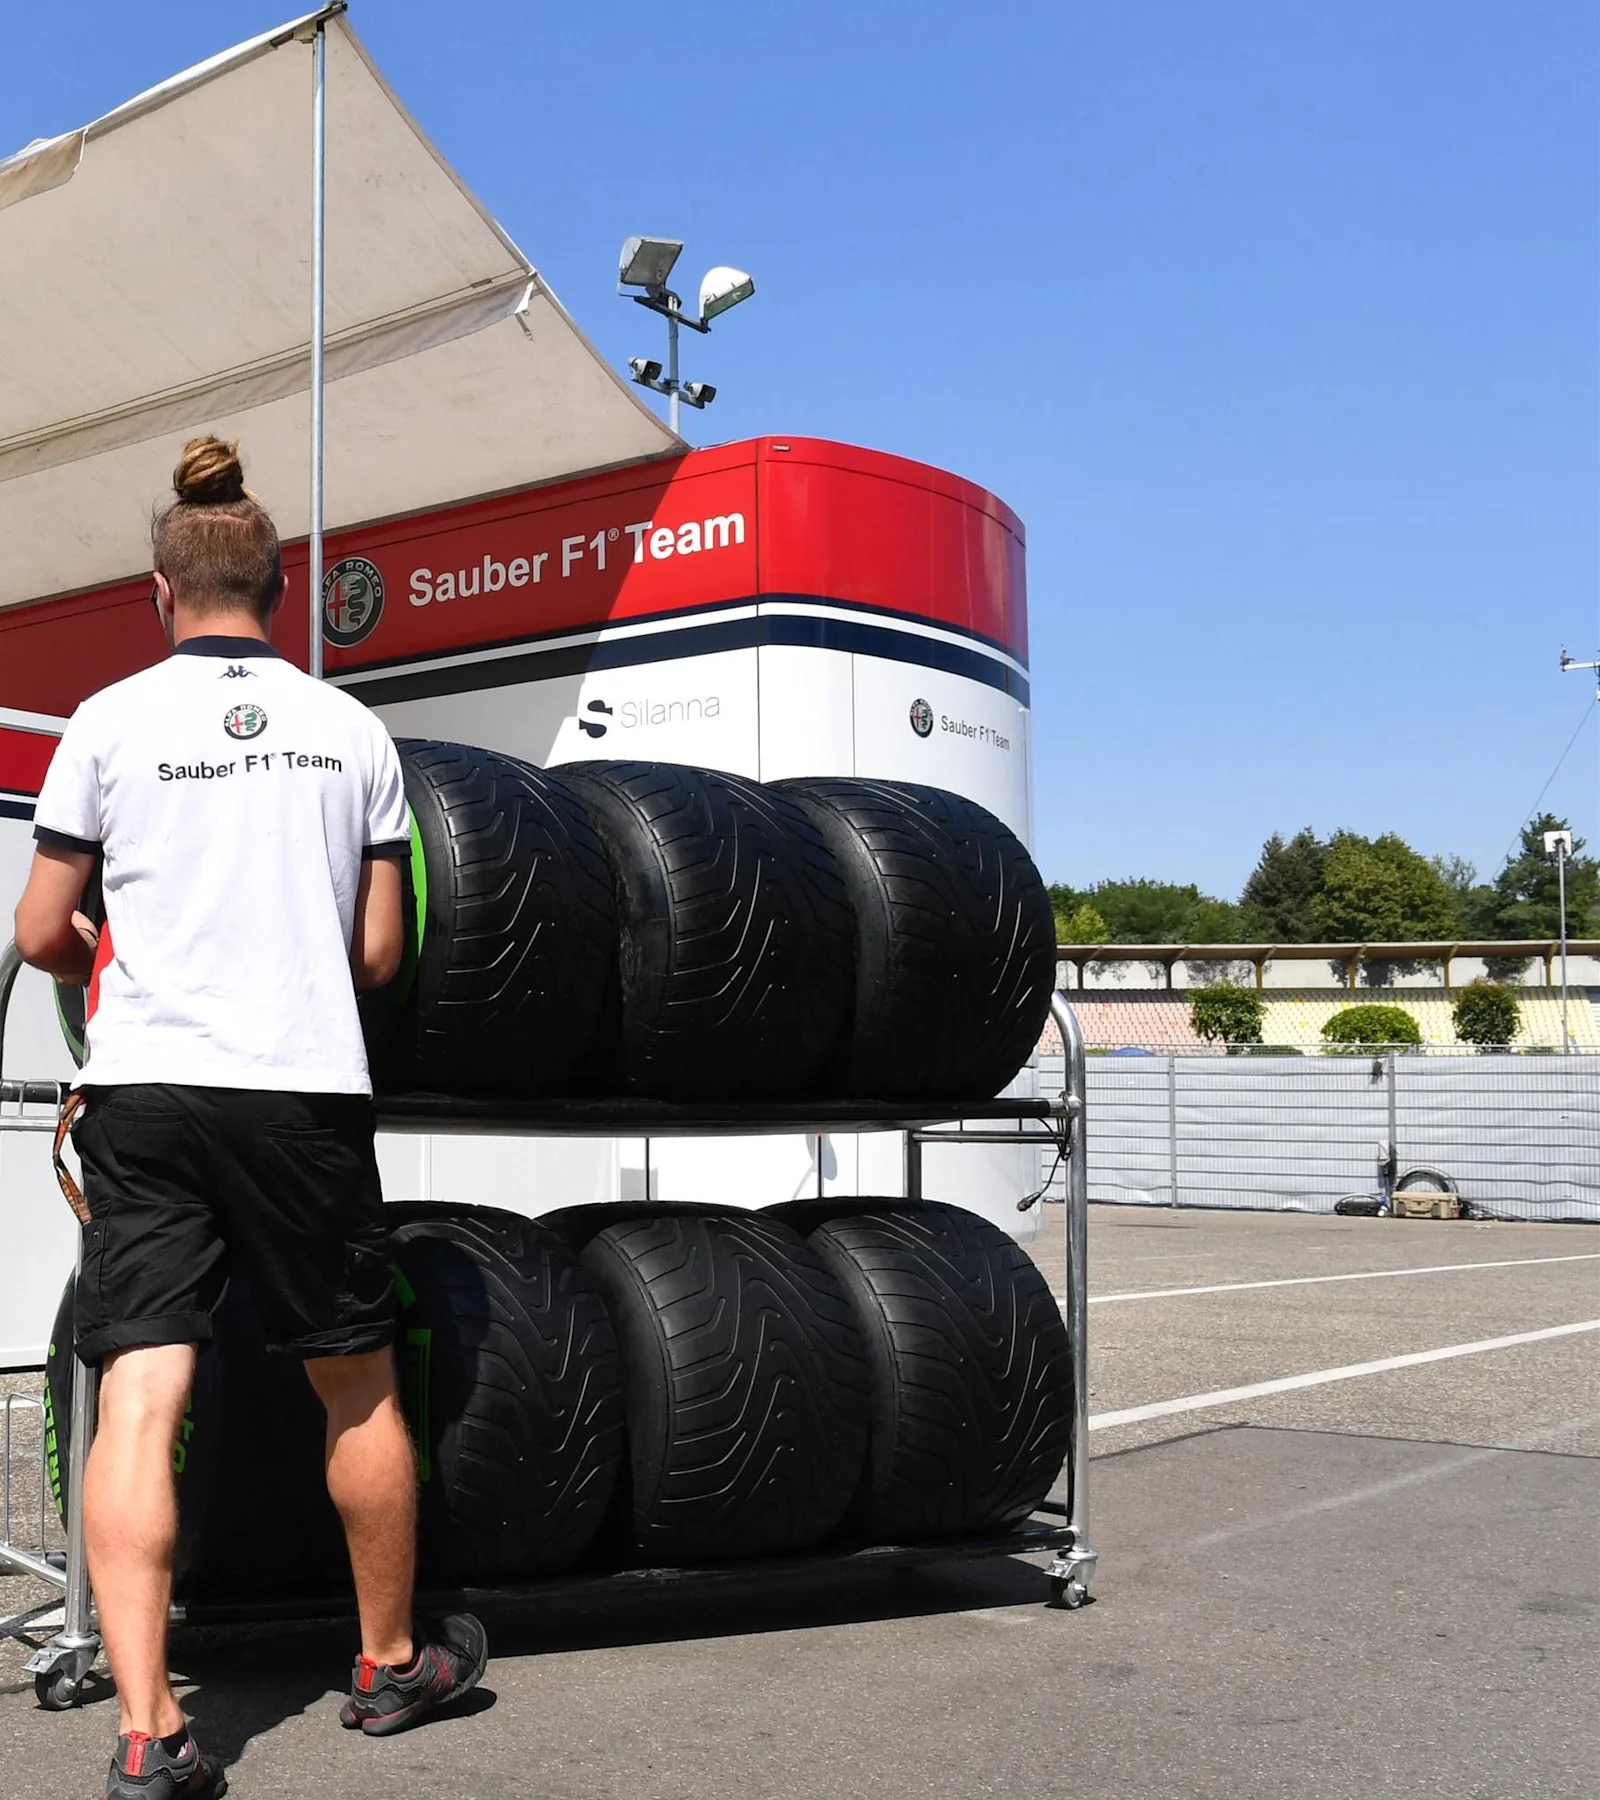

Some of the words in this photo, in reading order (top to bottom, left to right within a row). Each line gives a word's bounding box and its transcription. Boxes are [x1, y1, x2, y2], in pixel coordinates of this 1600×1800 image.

[408, 552, 549, 607] Sauber
[625, 512, 745, 564] Team
[346, 561, 382, 597] ROMEO
[621, 696, 720, 728] Silanna
[941, 715, 977, 739] Sauber
[158, 761, 236, 781] Sauber
[282, 751, 342, 773] Team
